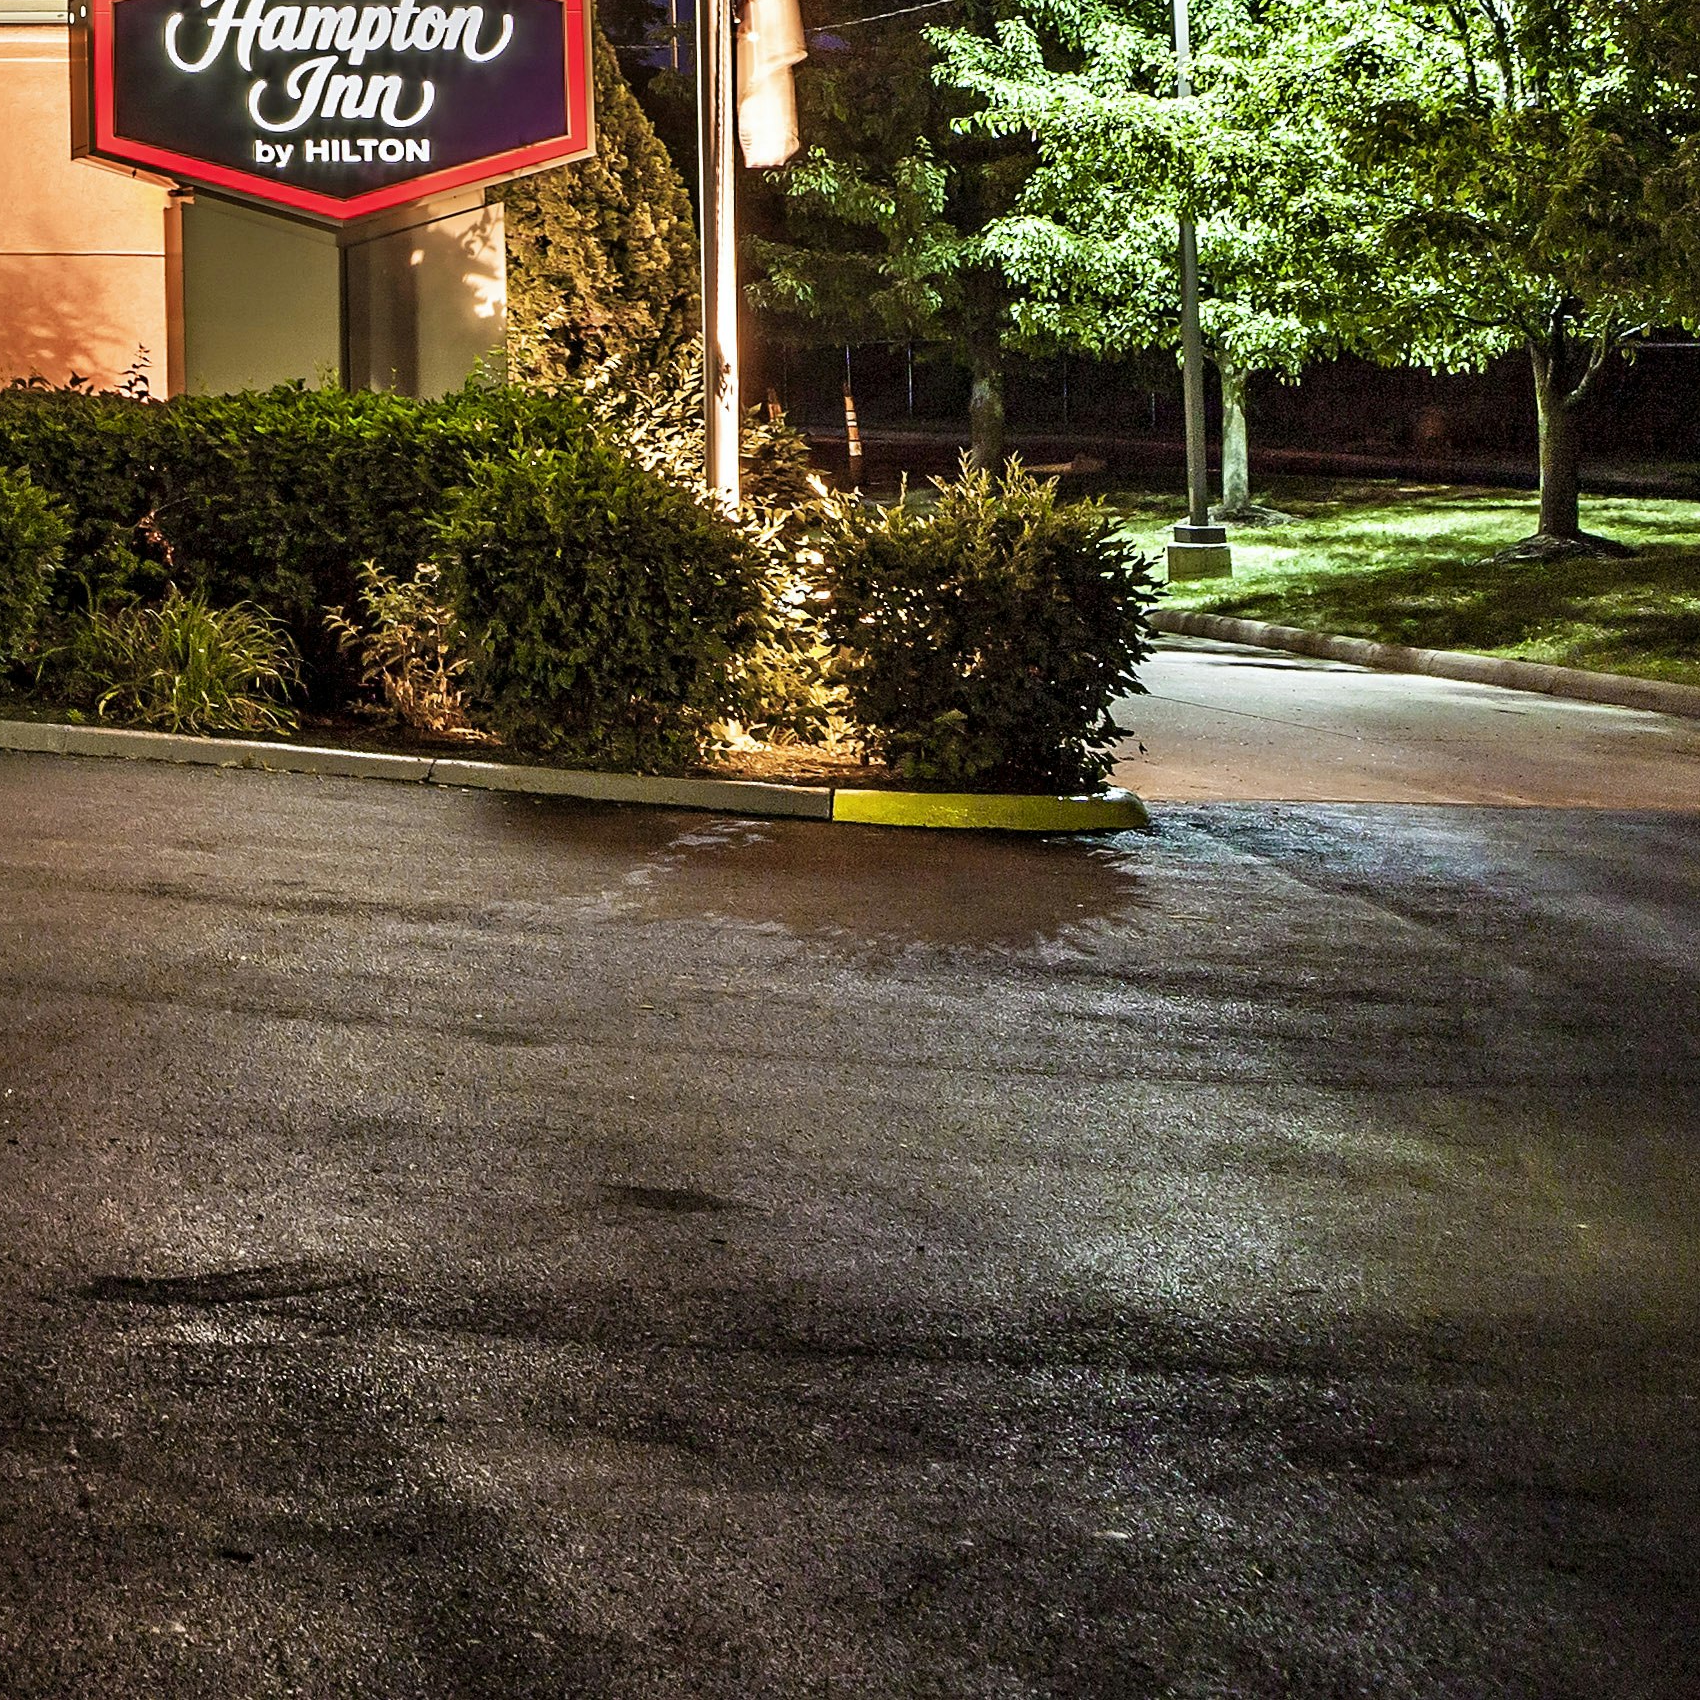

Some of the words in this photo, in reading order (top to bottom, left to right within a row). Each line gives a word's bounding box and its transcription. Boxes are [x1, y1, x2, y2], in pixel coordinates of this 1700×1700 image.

[247, 56, 436, 133] Inn
[254, 139, 295, 168] by
[304, 138, 431, 163] HILTON
